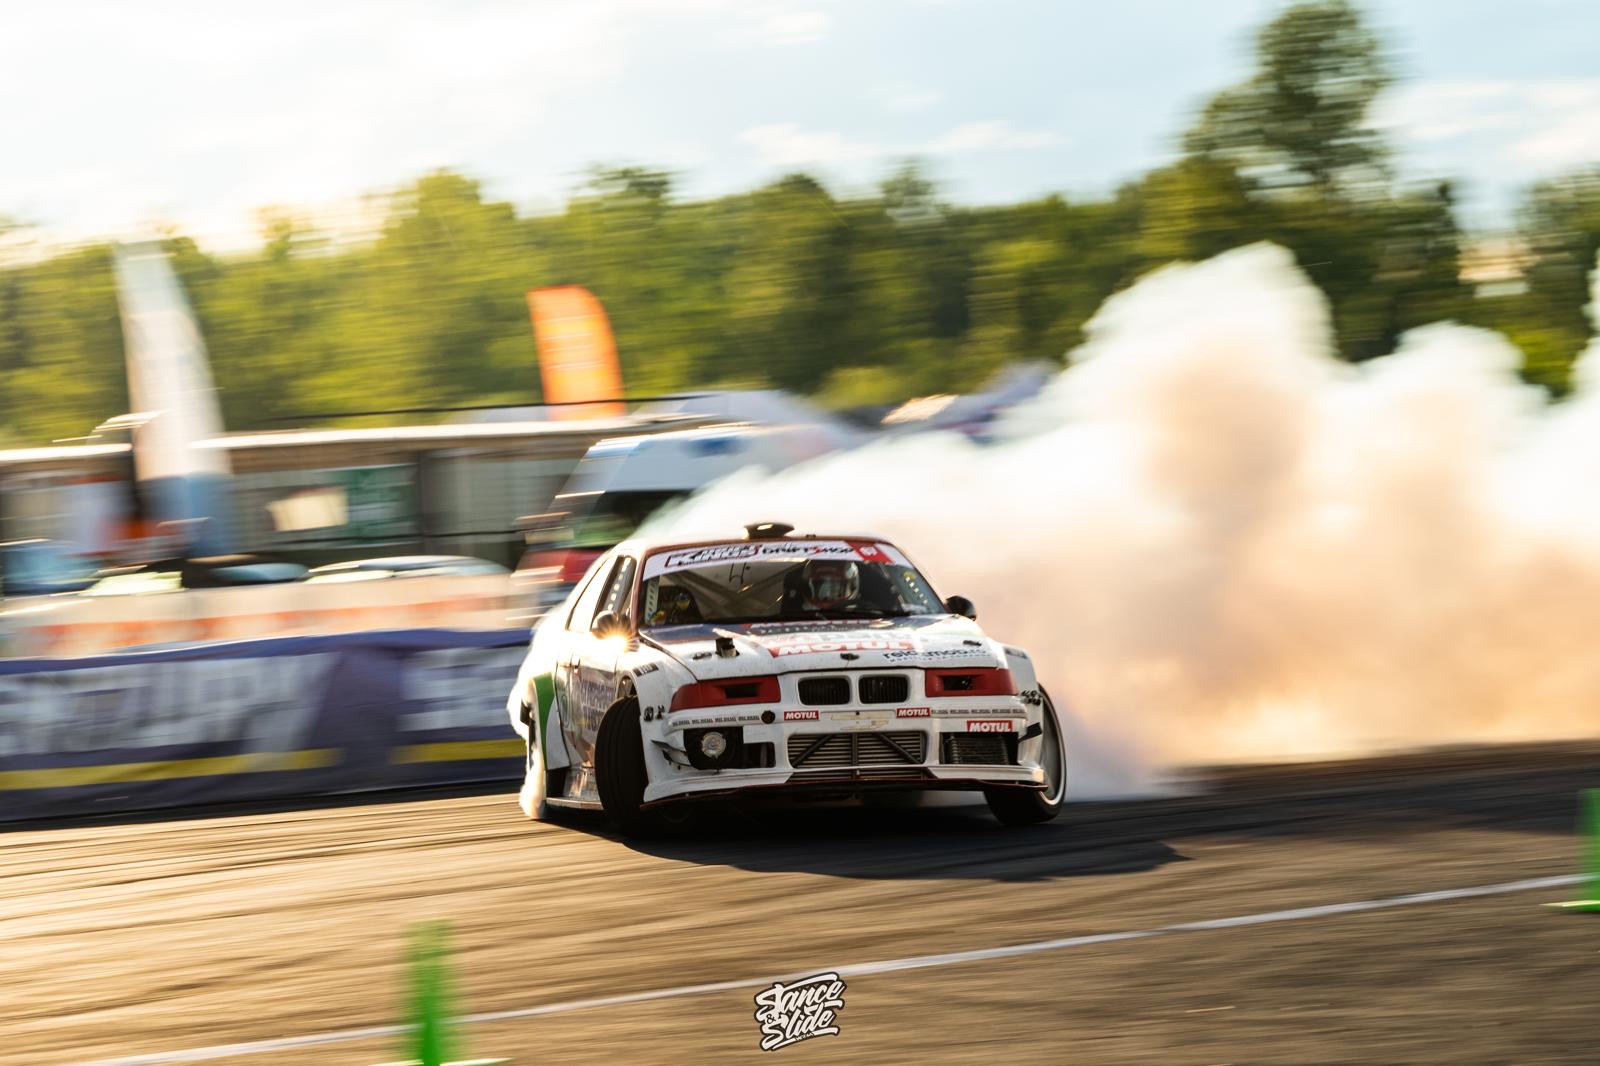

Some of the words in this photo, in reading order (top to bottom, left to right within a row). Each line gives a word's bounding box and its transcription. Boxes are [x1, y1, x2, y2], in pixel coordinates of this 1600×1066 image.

[777, 640, 911, 656] MOTUL
[785, 711, 817, 720] MOTUL
[898, 708, 929, 717] MOTUL
[969, 722, 1011, 732] MOTUL
